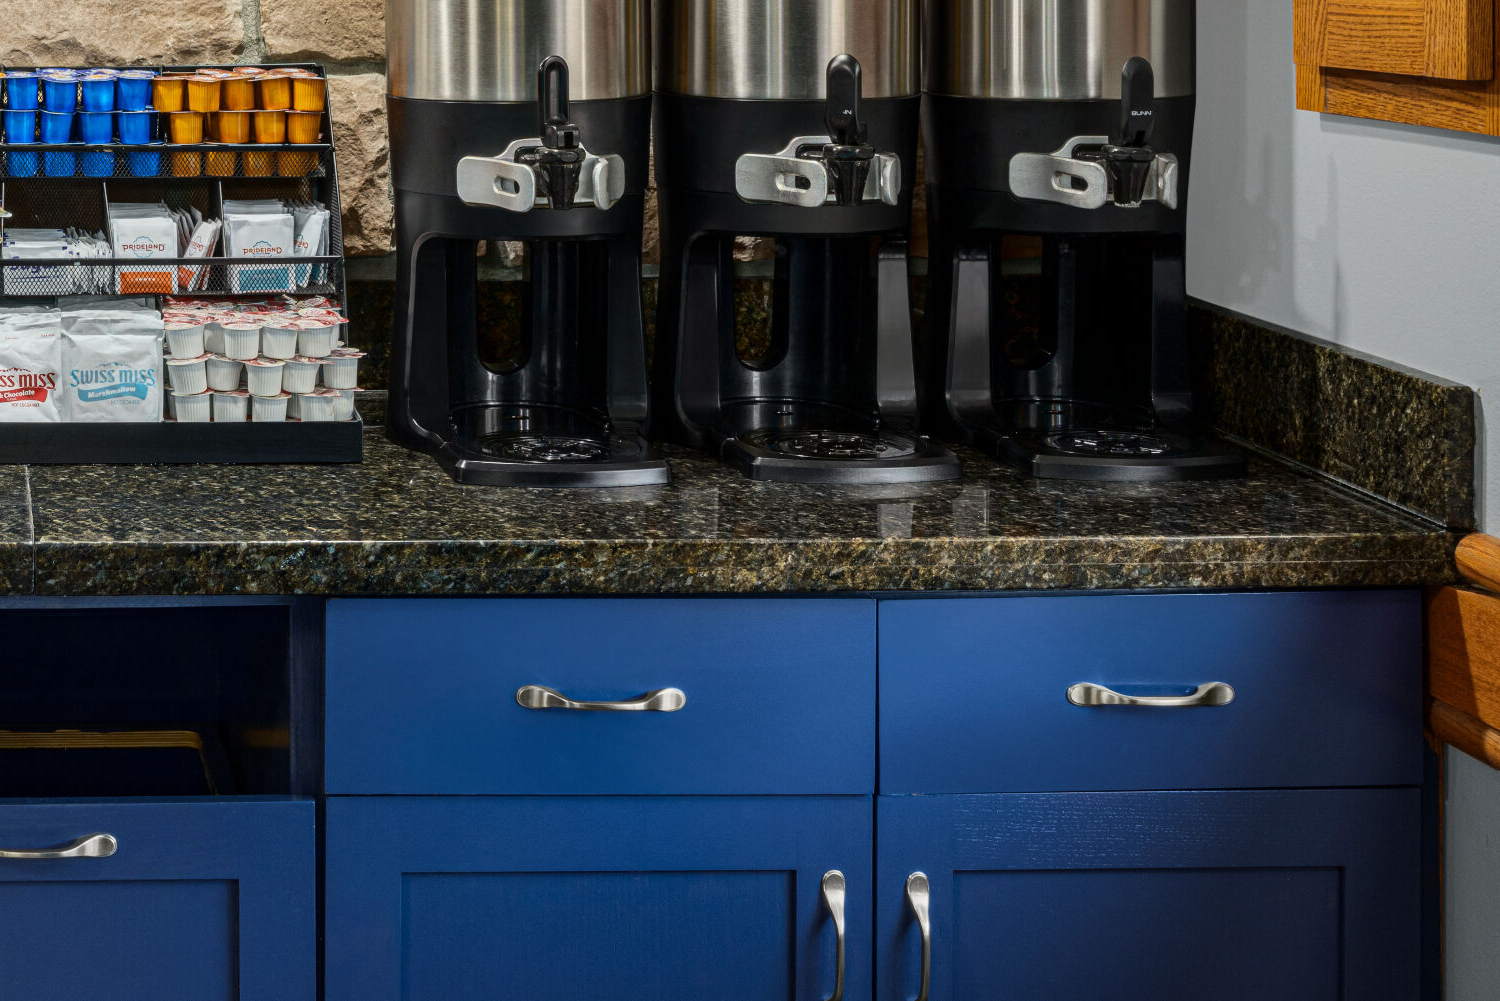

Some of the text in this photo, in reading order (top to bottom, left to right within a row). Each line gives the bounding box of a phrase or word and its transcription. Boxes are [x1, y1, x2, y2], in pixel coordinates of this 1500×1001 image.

[122, 244, 165, 252] PRIDELAND
[243, 246, 282, 255] PRIDELAND
[18, 372, 56, 390] MISS
[71, 369, 115, 387] SWISS
[4, 389, 35, 398] Chocolate
[88, 386, 136, 398] Marshmallow
